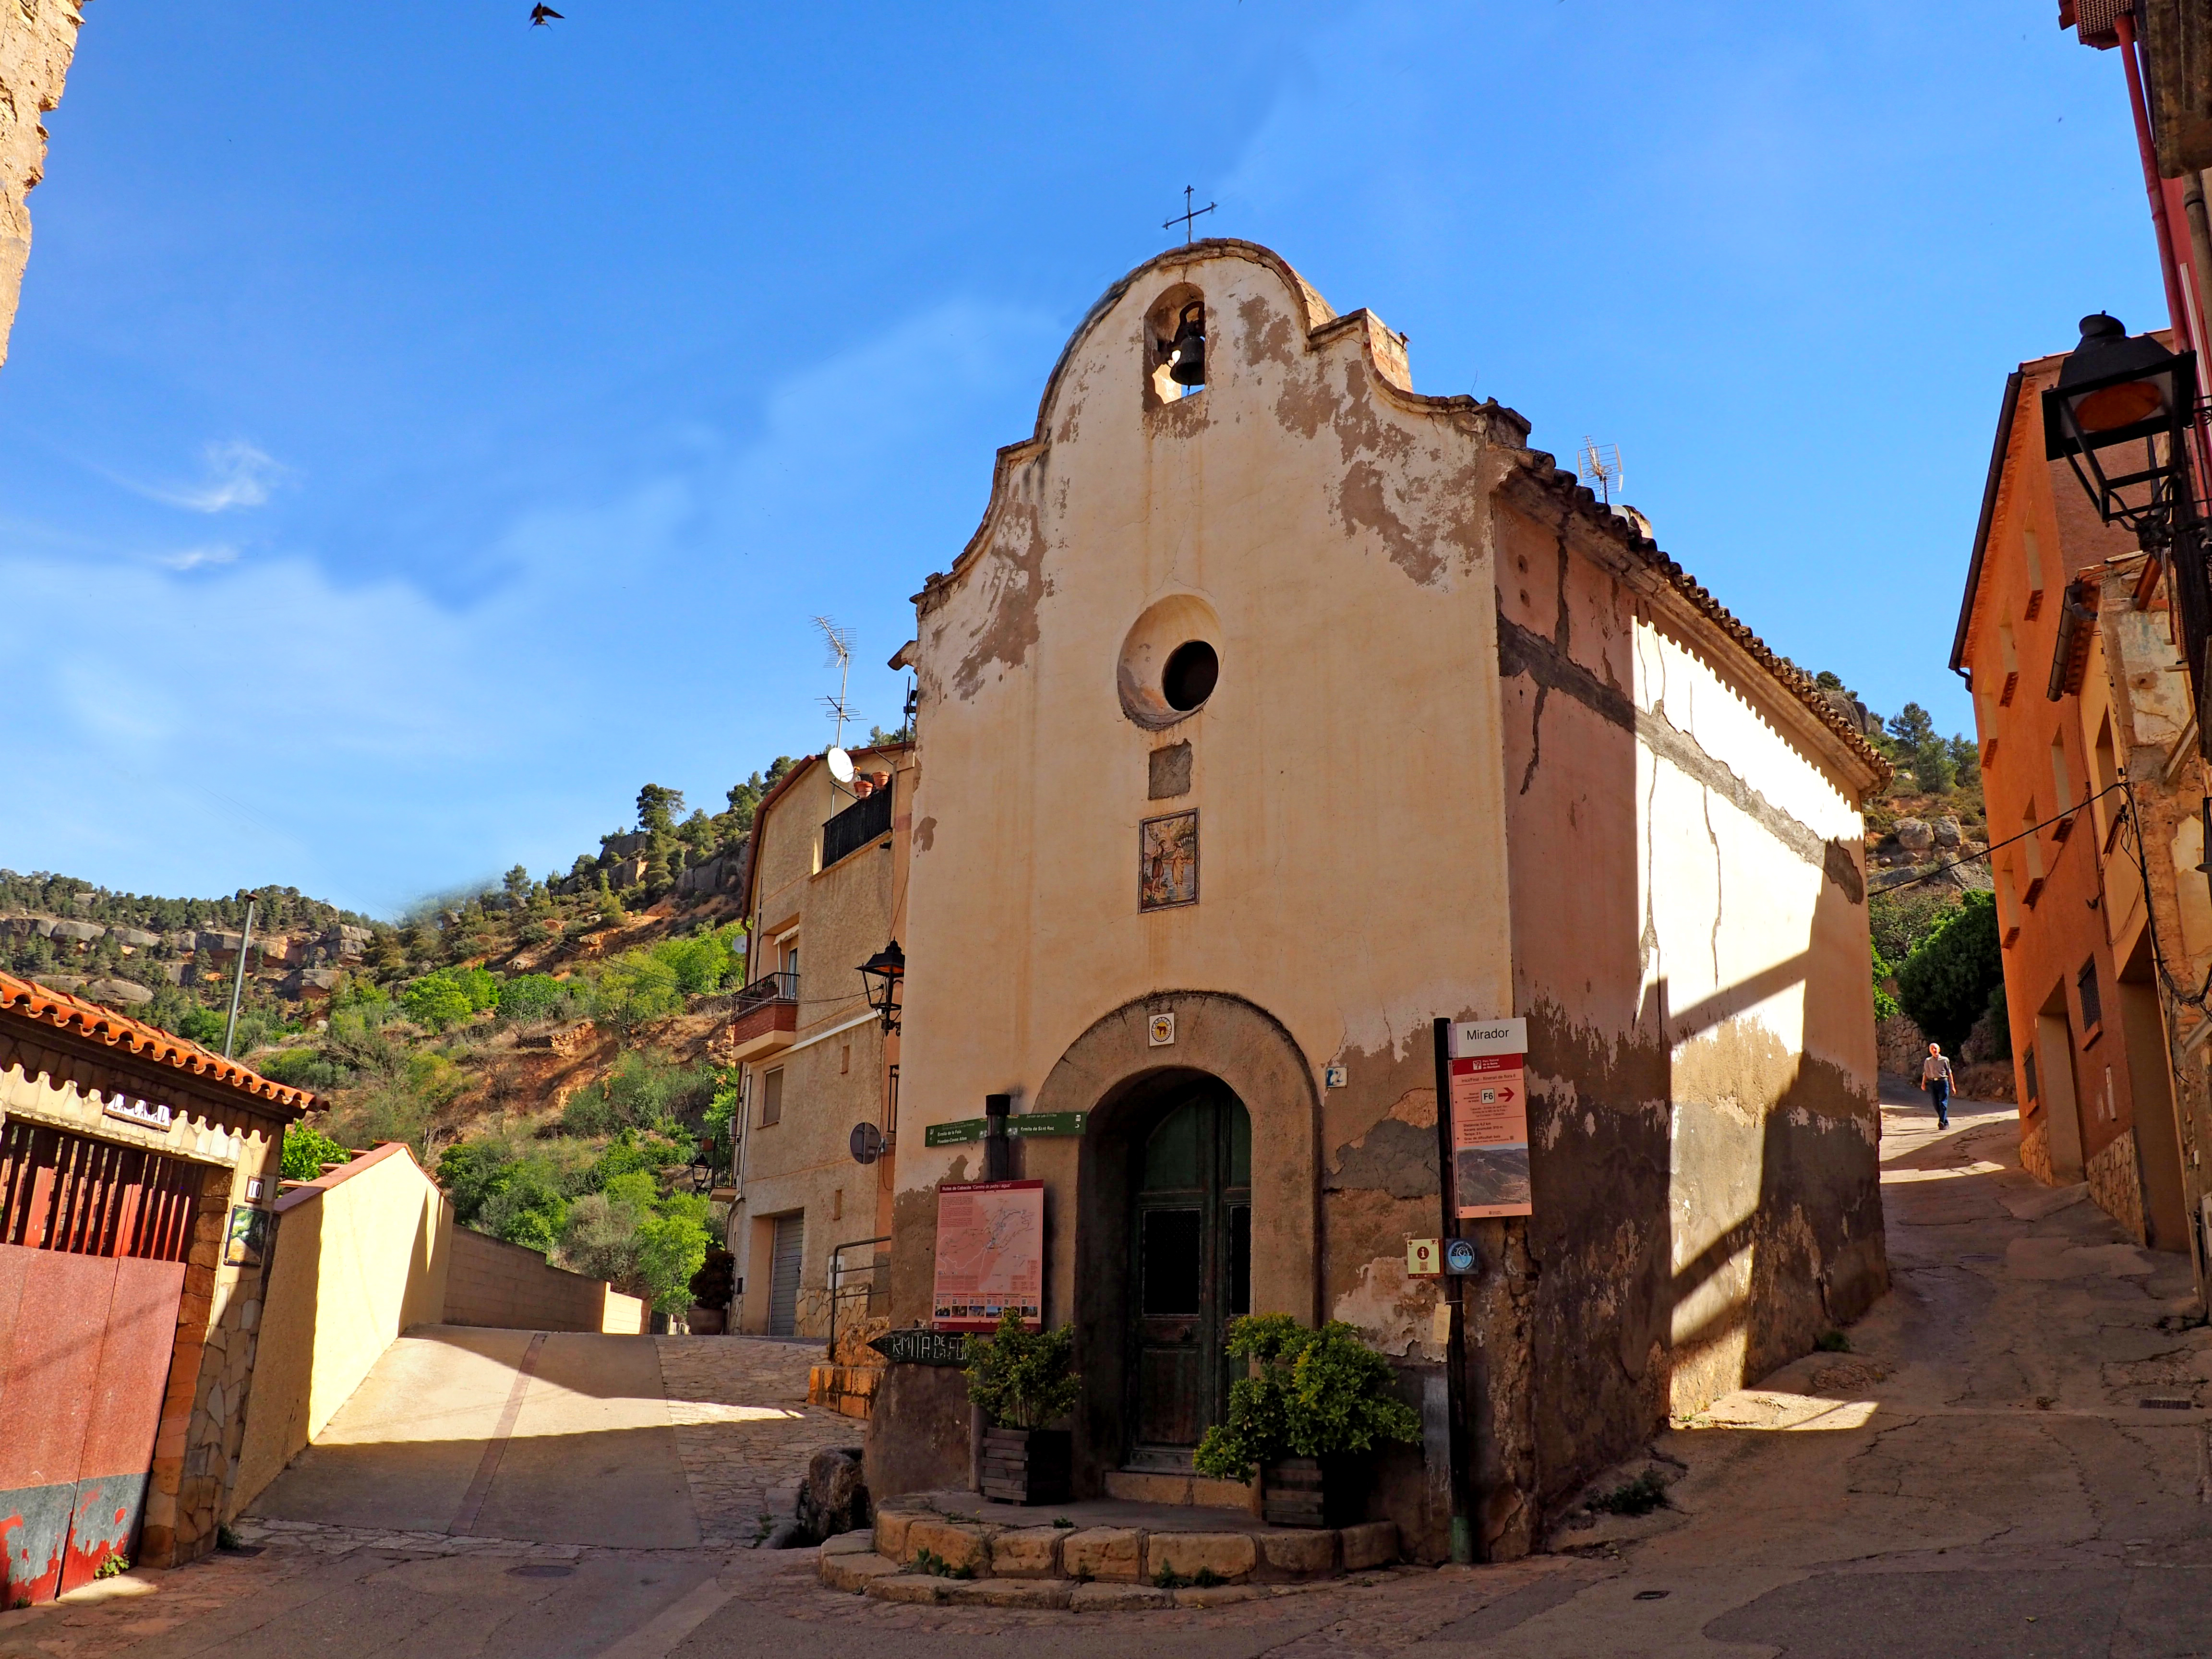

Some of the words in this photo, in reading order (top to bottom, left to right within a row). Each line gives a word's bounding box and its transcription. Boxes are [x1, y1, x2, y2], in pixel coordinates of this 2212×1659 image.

[1467, 1028, 1509, 1040] Mirador
[1330, 1069, 1344, 1085] 2
[113, 1094, 124, 1112] LA
[133, 1101, 165, 1122] CANAL
[251, 1182, 260, 1197] 10
